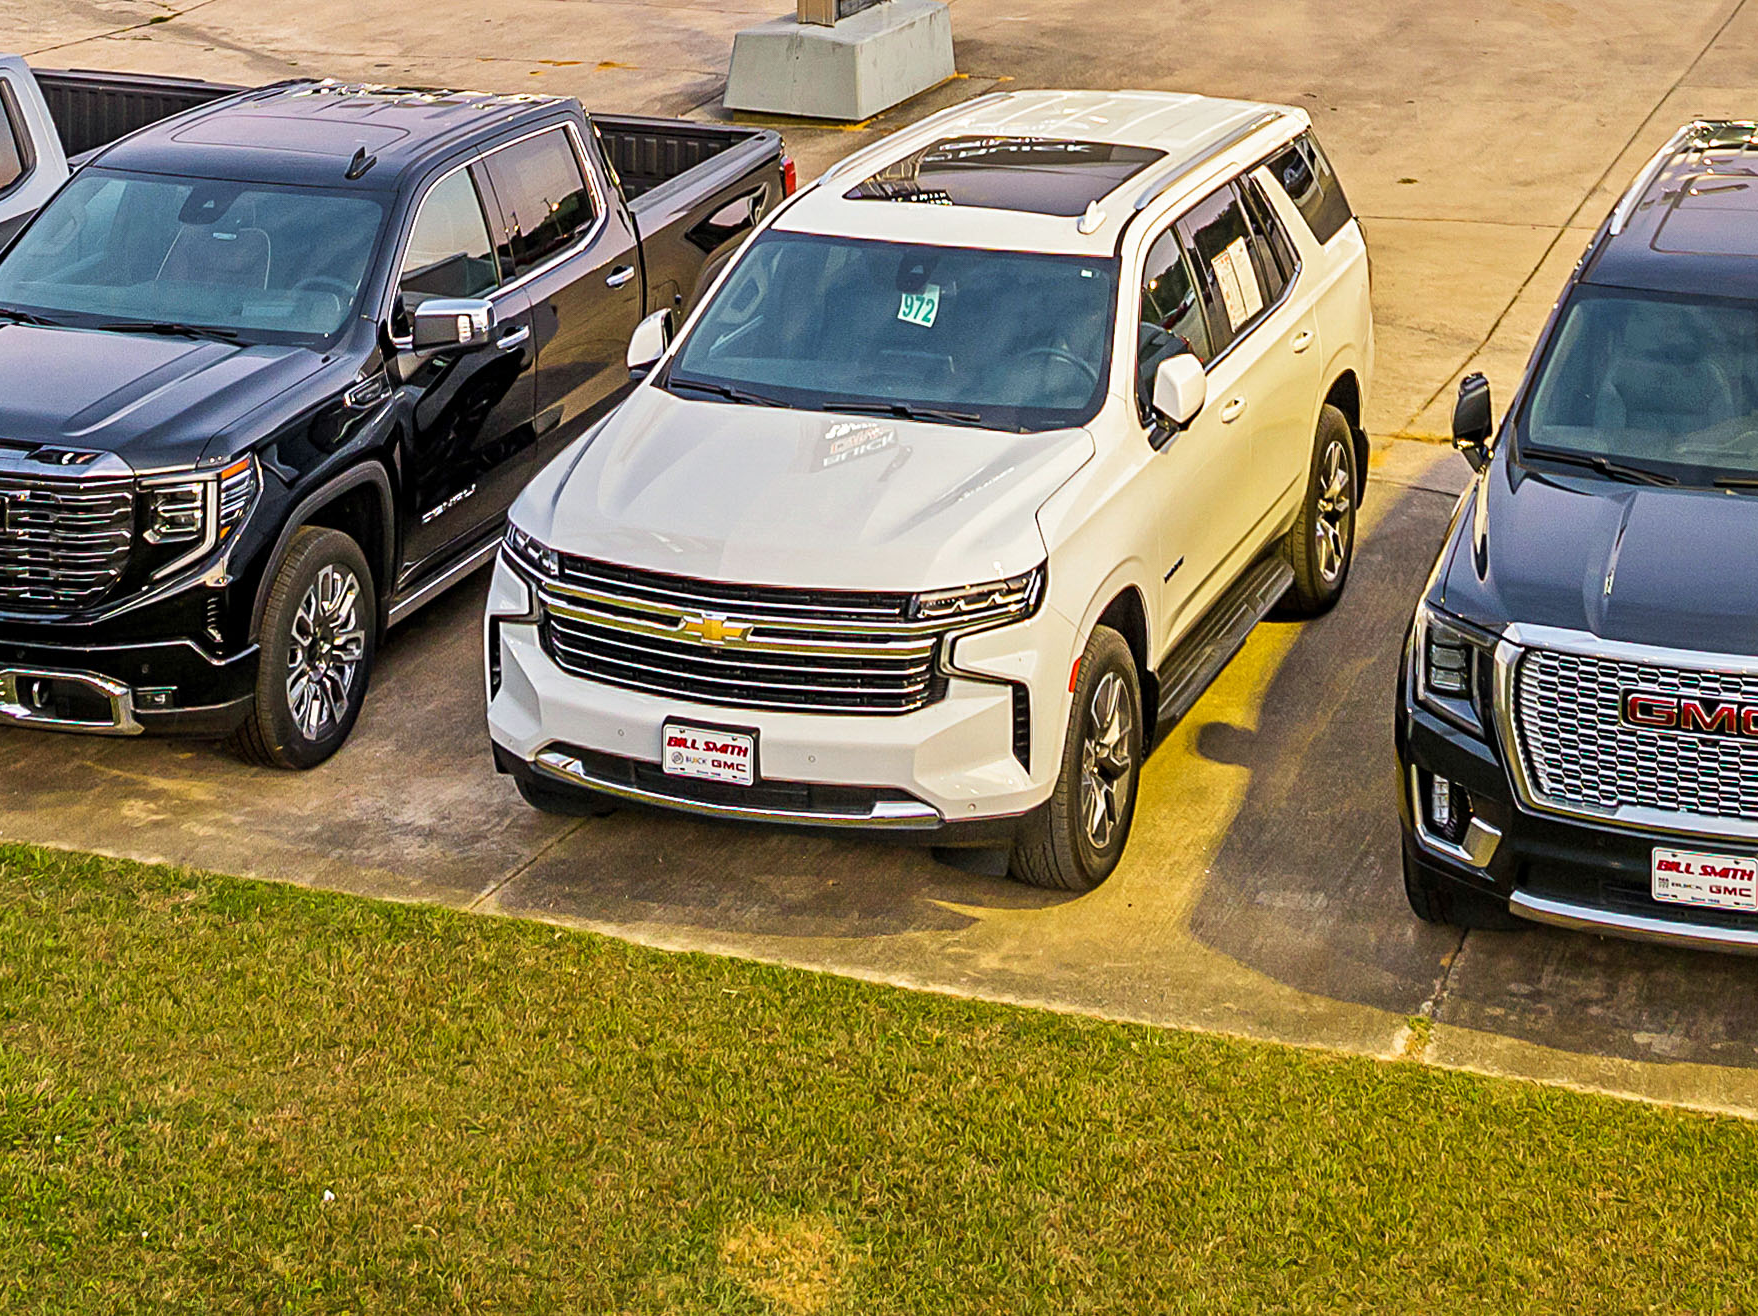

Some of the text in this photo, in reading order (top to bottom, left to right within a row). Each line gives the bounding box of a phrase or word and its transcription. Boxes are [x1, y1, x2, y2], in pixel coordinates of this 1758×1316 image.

[903, 294, 935, 323] 972
[667, 736, 748, 758] BILL SMITH
[711, 759, 746, 772] GMC
[1656, 859, 1754, 881] BILL SMITH
[1709, 885, 1752, 898] GMC
